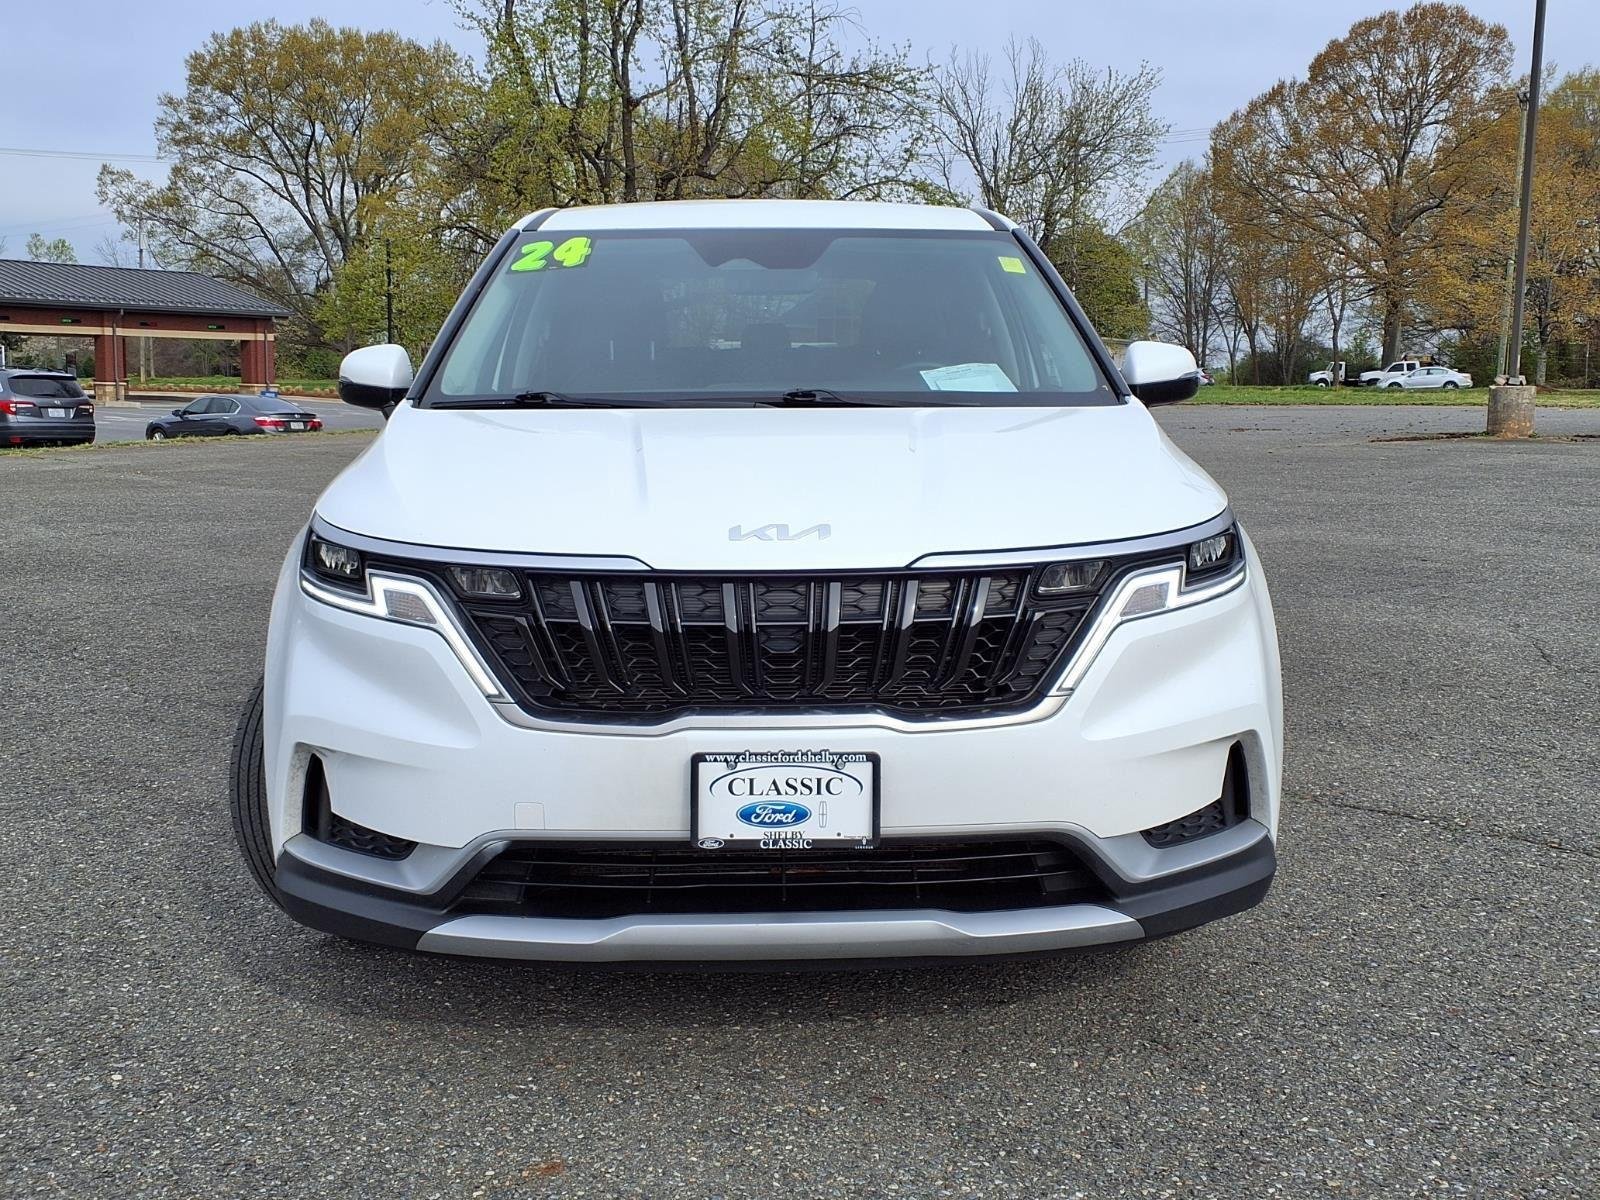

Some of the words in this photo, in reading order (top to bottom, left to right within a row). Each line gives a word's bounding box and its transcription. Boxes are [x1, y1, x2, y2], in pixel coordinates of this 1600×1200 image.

[510, 237, 592, 271] 24
[705, 750, 867, 764] www.classicfordshelby.com
[727, 777, 844, 797] CLASSIC
[751, 803, 797, 824] Ford
[759, 838, 813, 849] CLASSIC
[763, 830, 805, 840] SHELBY
